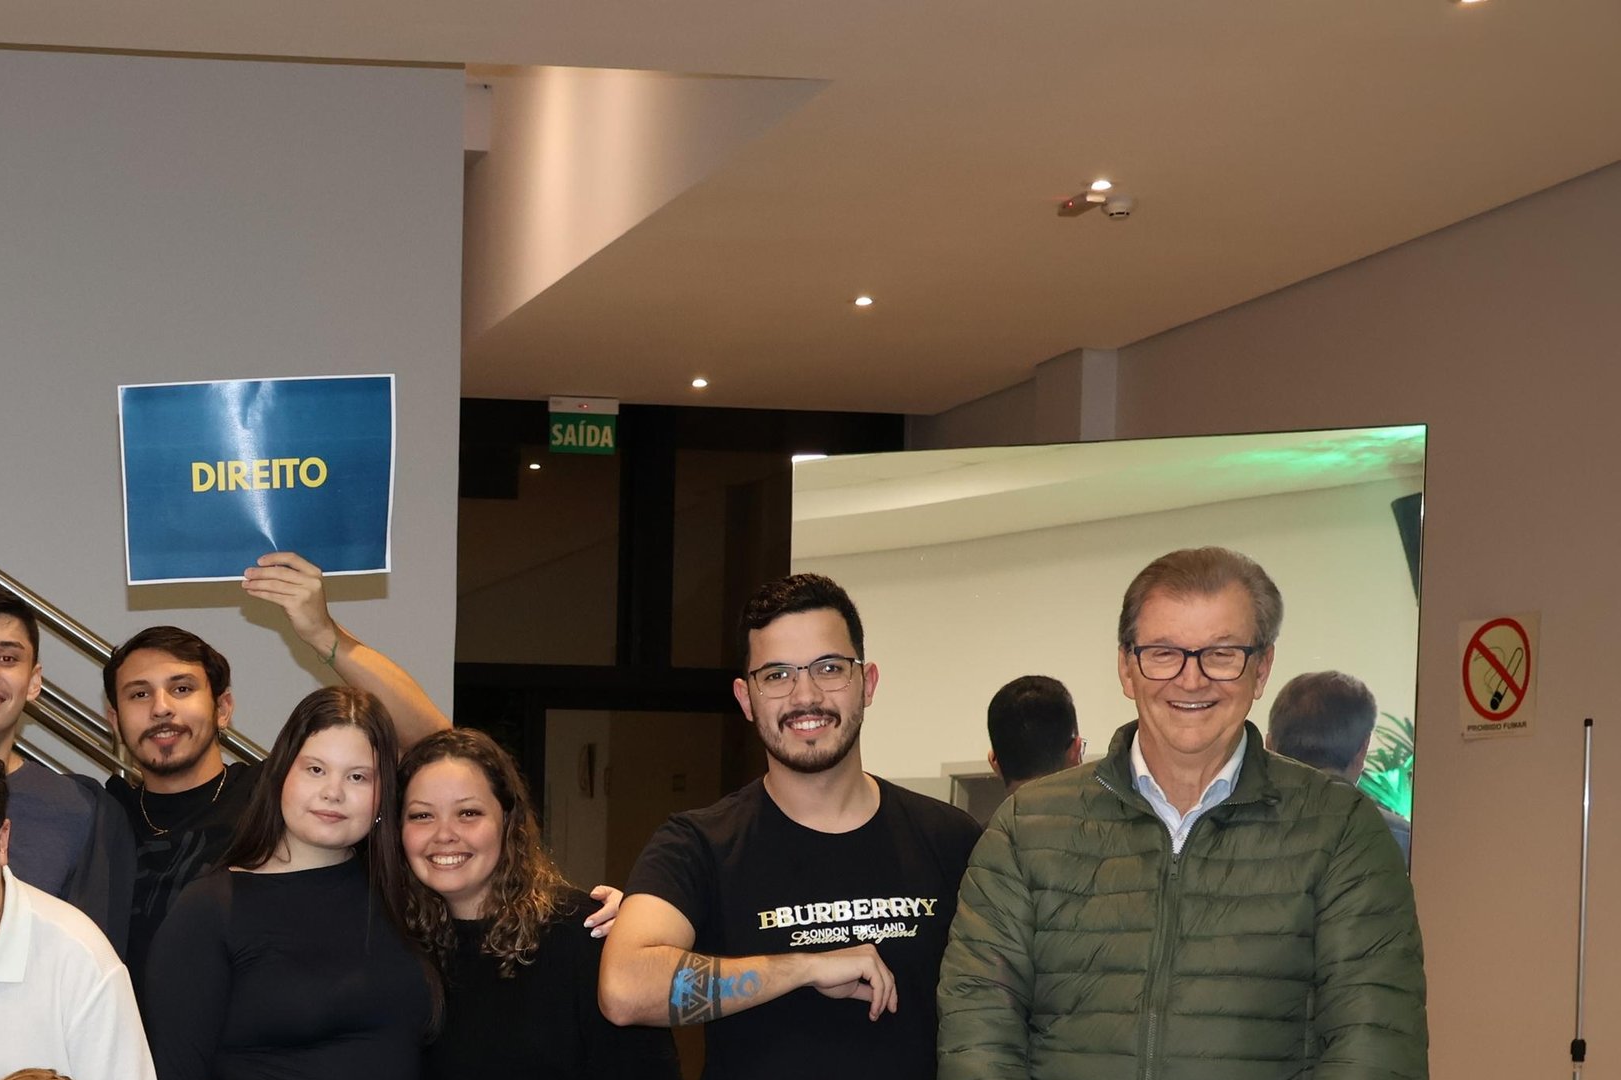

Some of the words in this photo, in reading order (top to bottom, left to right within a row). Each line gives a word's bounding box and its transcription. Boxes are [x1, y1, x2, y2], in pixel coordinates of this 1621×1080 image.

[551, 420, 615, 448] SAÍDA
[191, 456, 328, 493] DIREITO
[775, 896, 922, 929] BURBERRY
